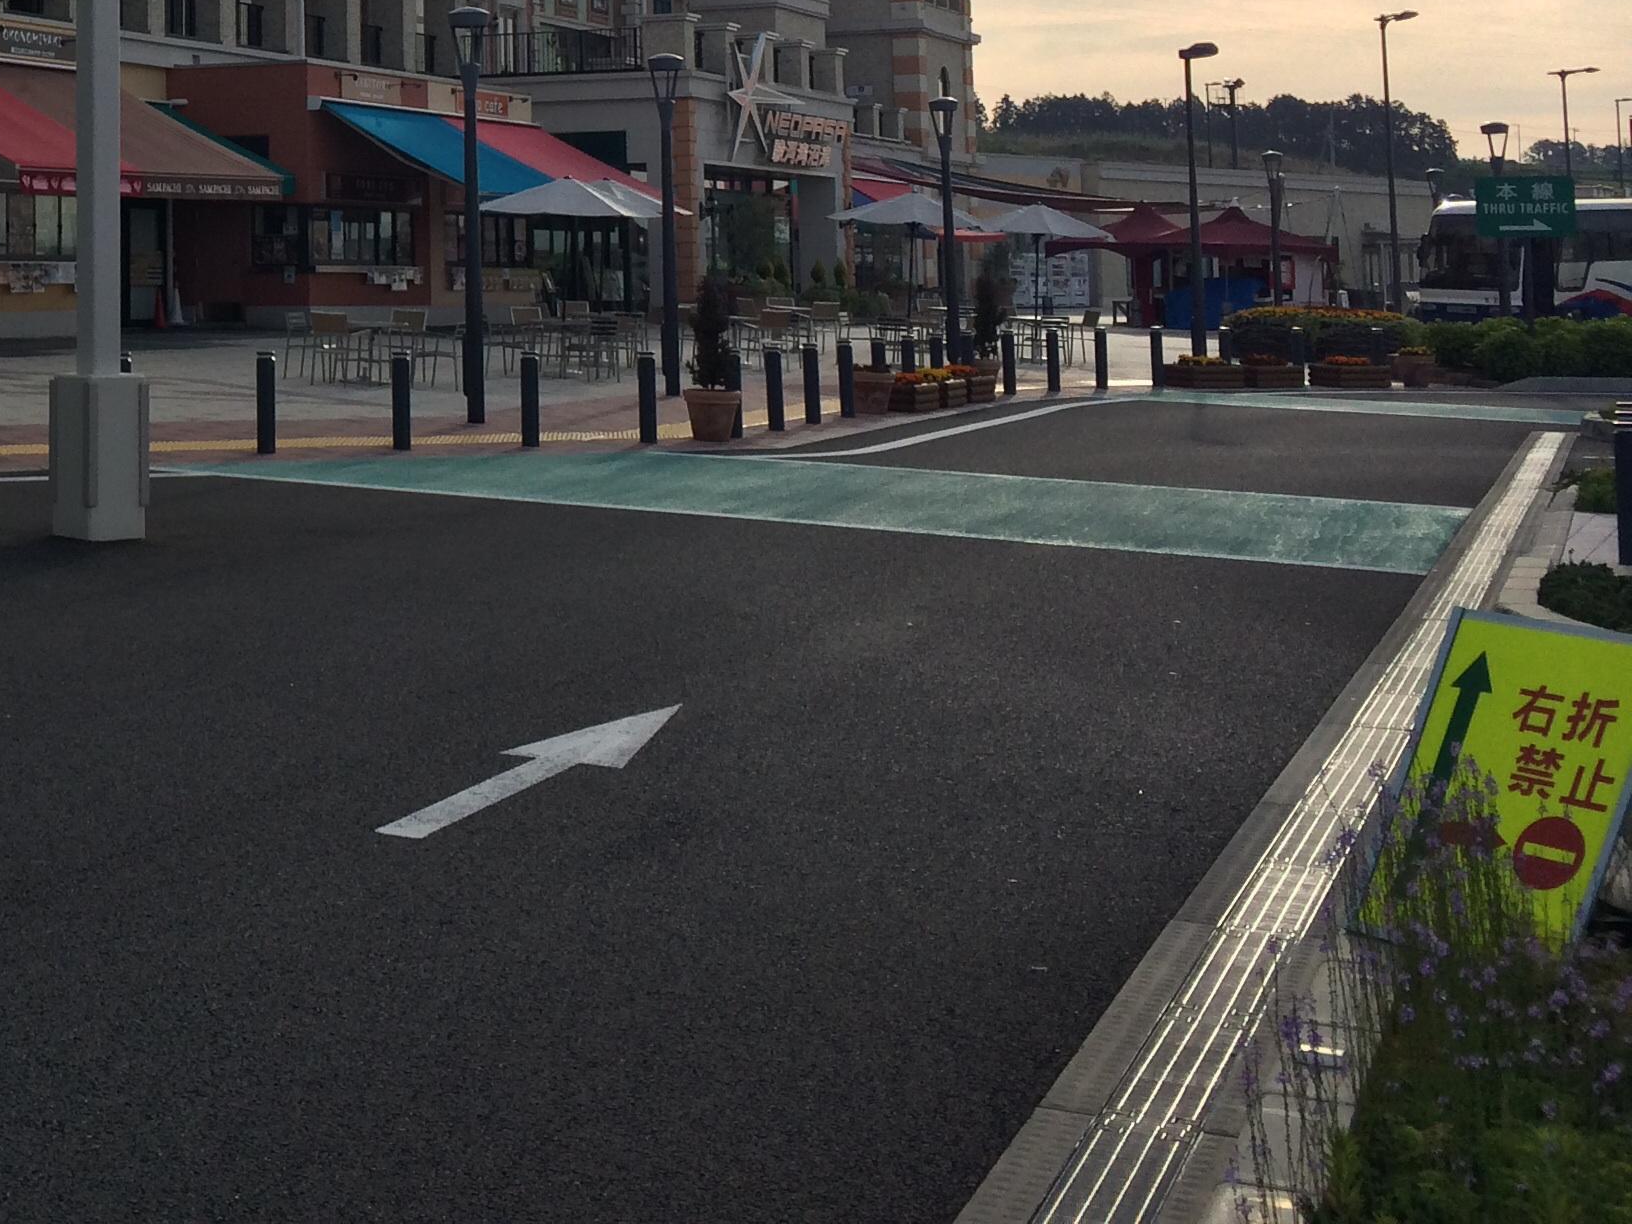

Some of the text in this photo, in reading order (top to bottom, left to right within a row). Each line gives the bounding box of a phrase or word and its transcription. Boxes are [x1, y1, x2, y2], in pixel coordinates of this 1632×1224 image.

[765, 110, 847, 144] NEOPASA
[1483, 203, 1569, 214] THRU TRAFFIC
[1496, 182, 1554, 201] 本線
[1512, 685, 1619, 748] 右折
[1508, 744, 1615, 812] 禁止
